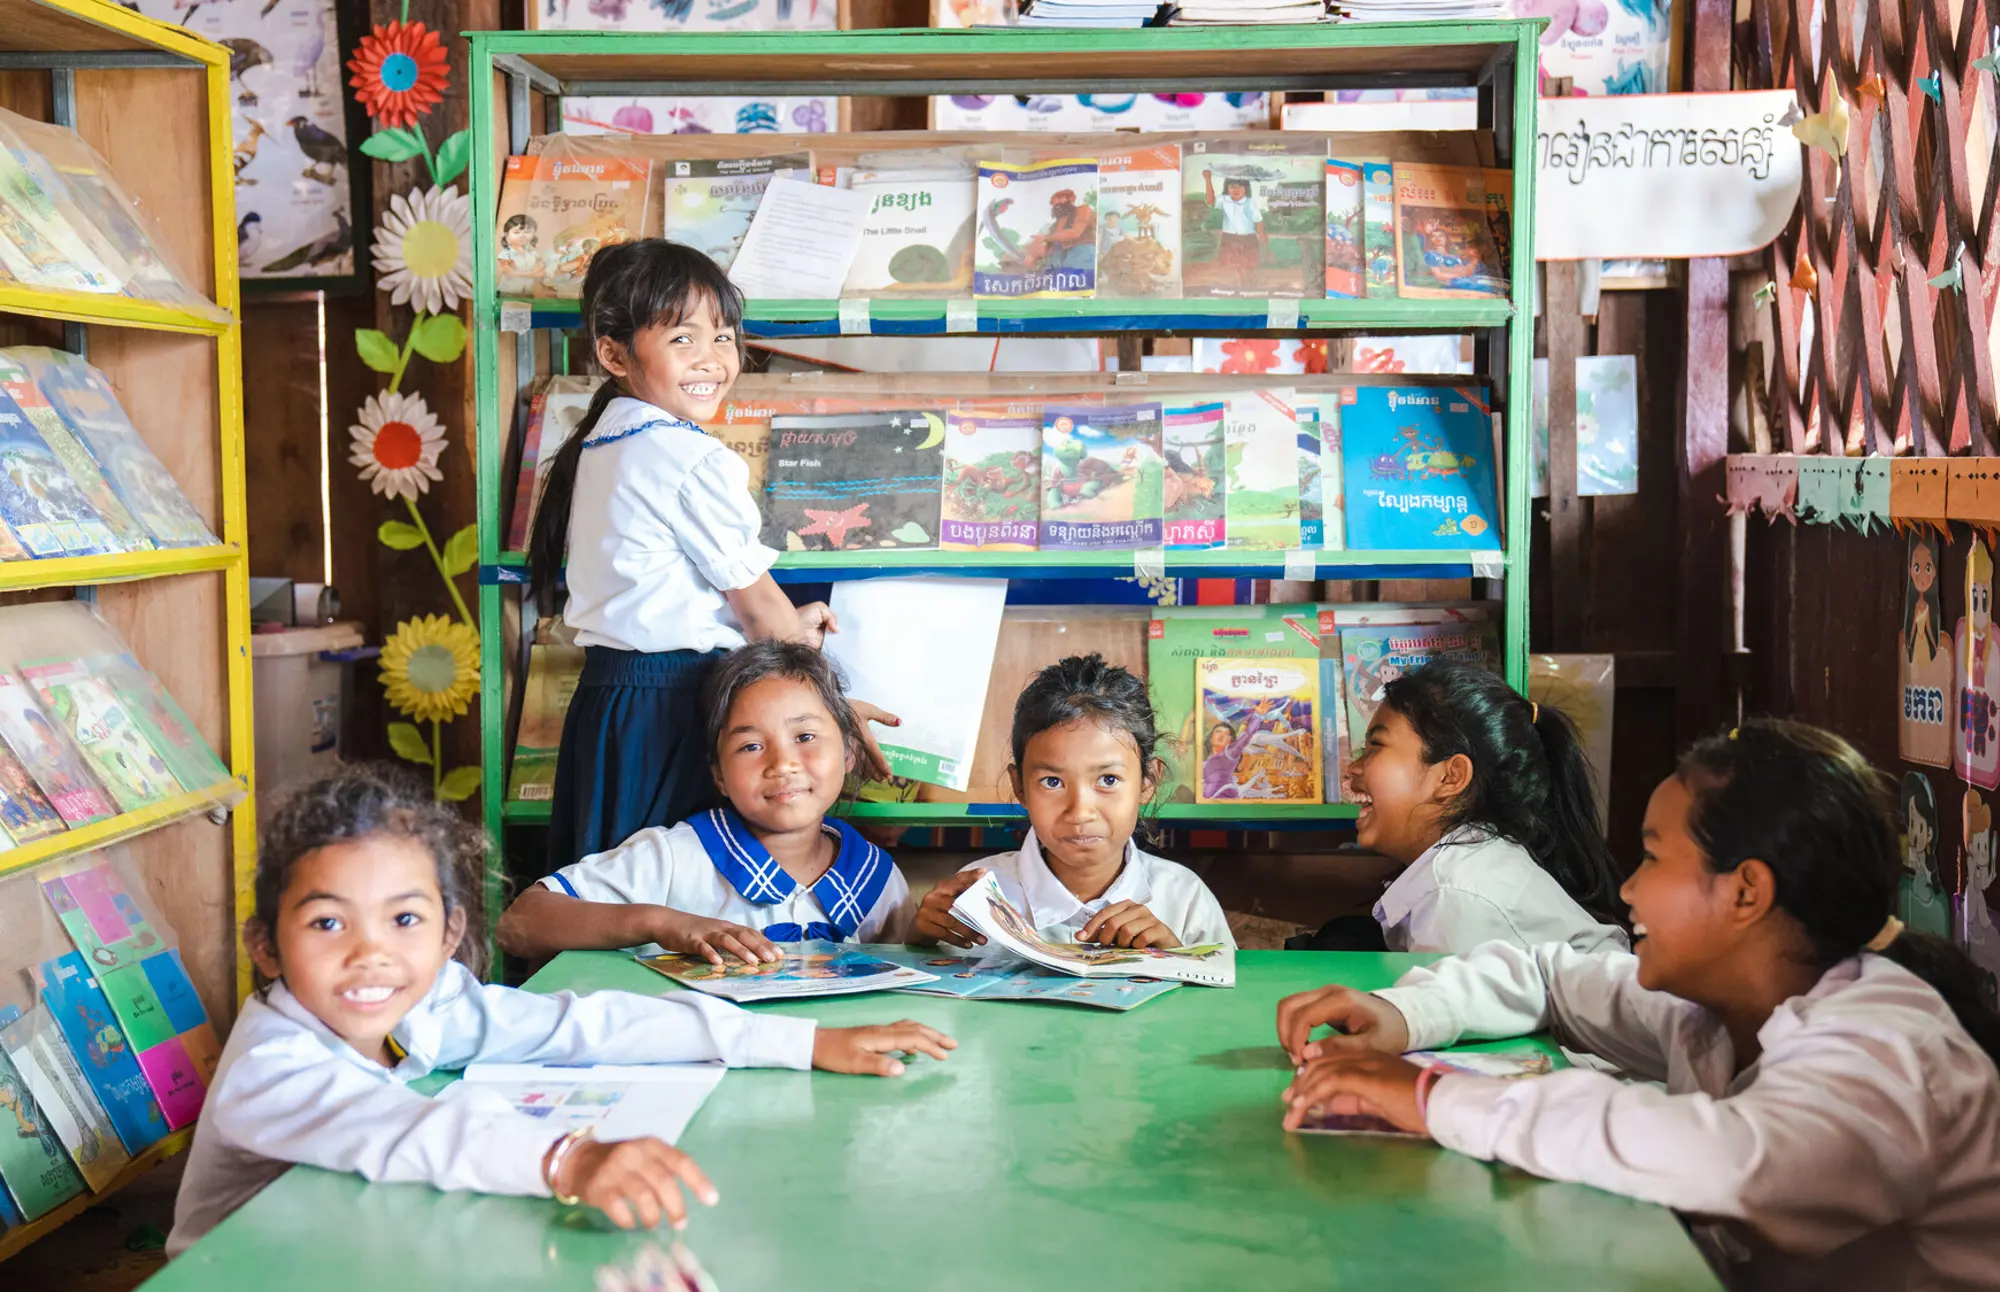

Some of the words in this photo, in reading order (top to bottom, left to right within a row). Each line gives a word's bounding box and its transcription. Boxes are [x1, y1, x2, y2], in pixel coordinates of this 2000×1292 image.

[871, 191, 932, 215] ូនខ្យង
[880, 227, 902, 235] Little
[904, 226, 927, 234] Snail
[778, 459, 798, 467] Star
[800, 458, 822, 467] Fish
[949, 519, 1037, 548] បងប្អូនពីរនា
[1390, 656, 1407, 665] My
